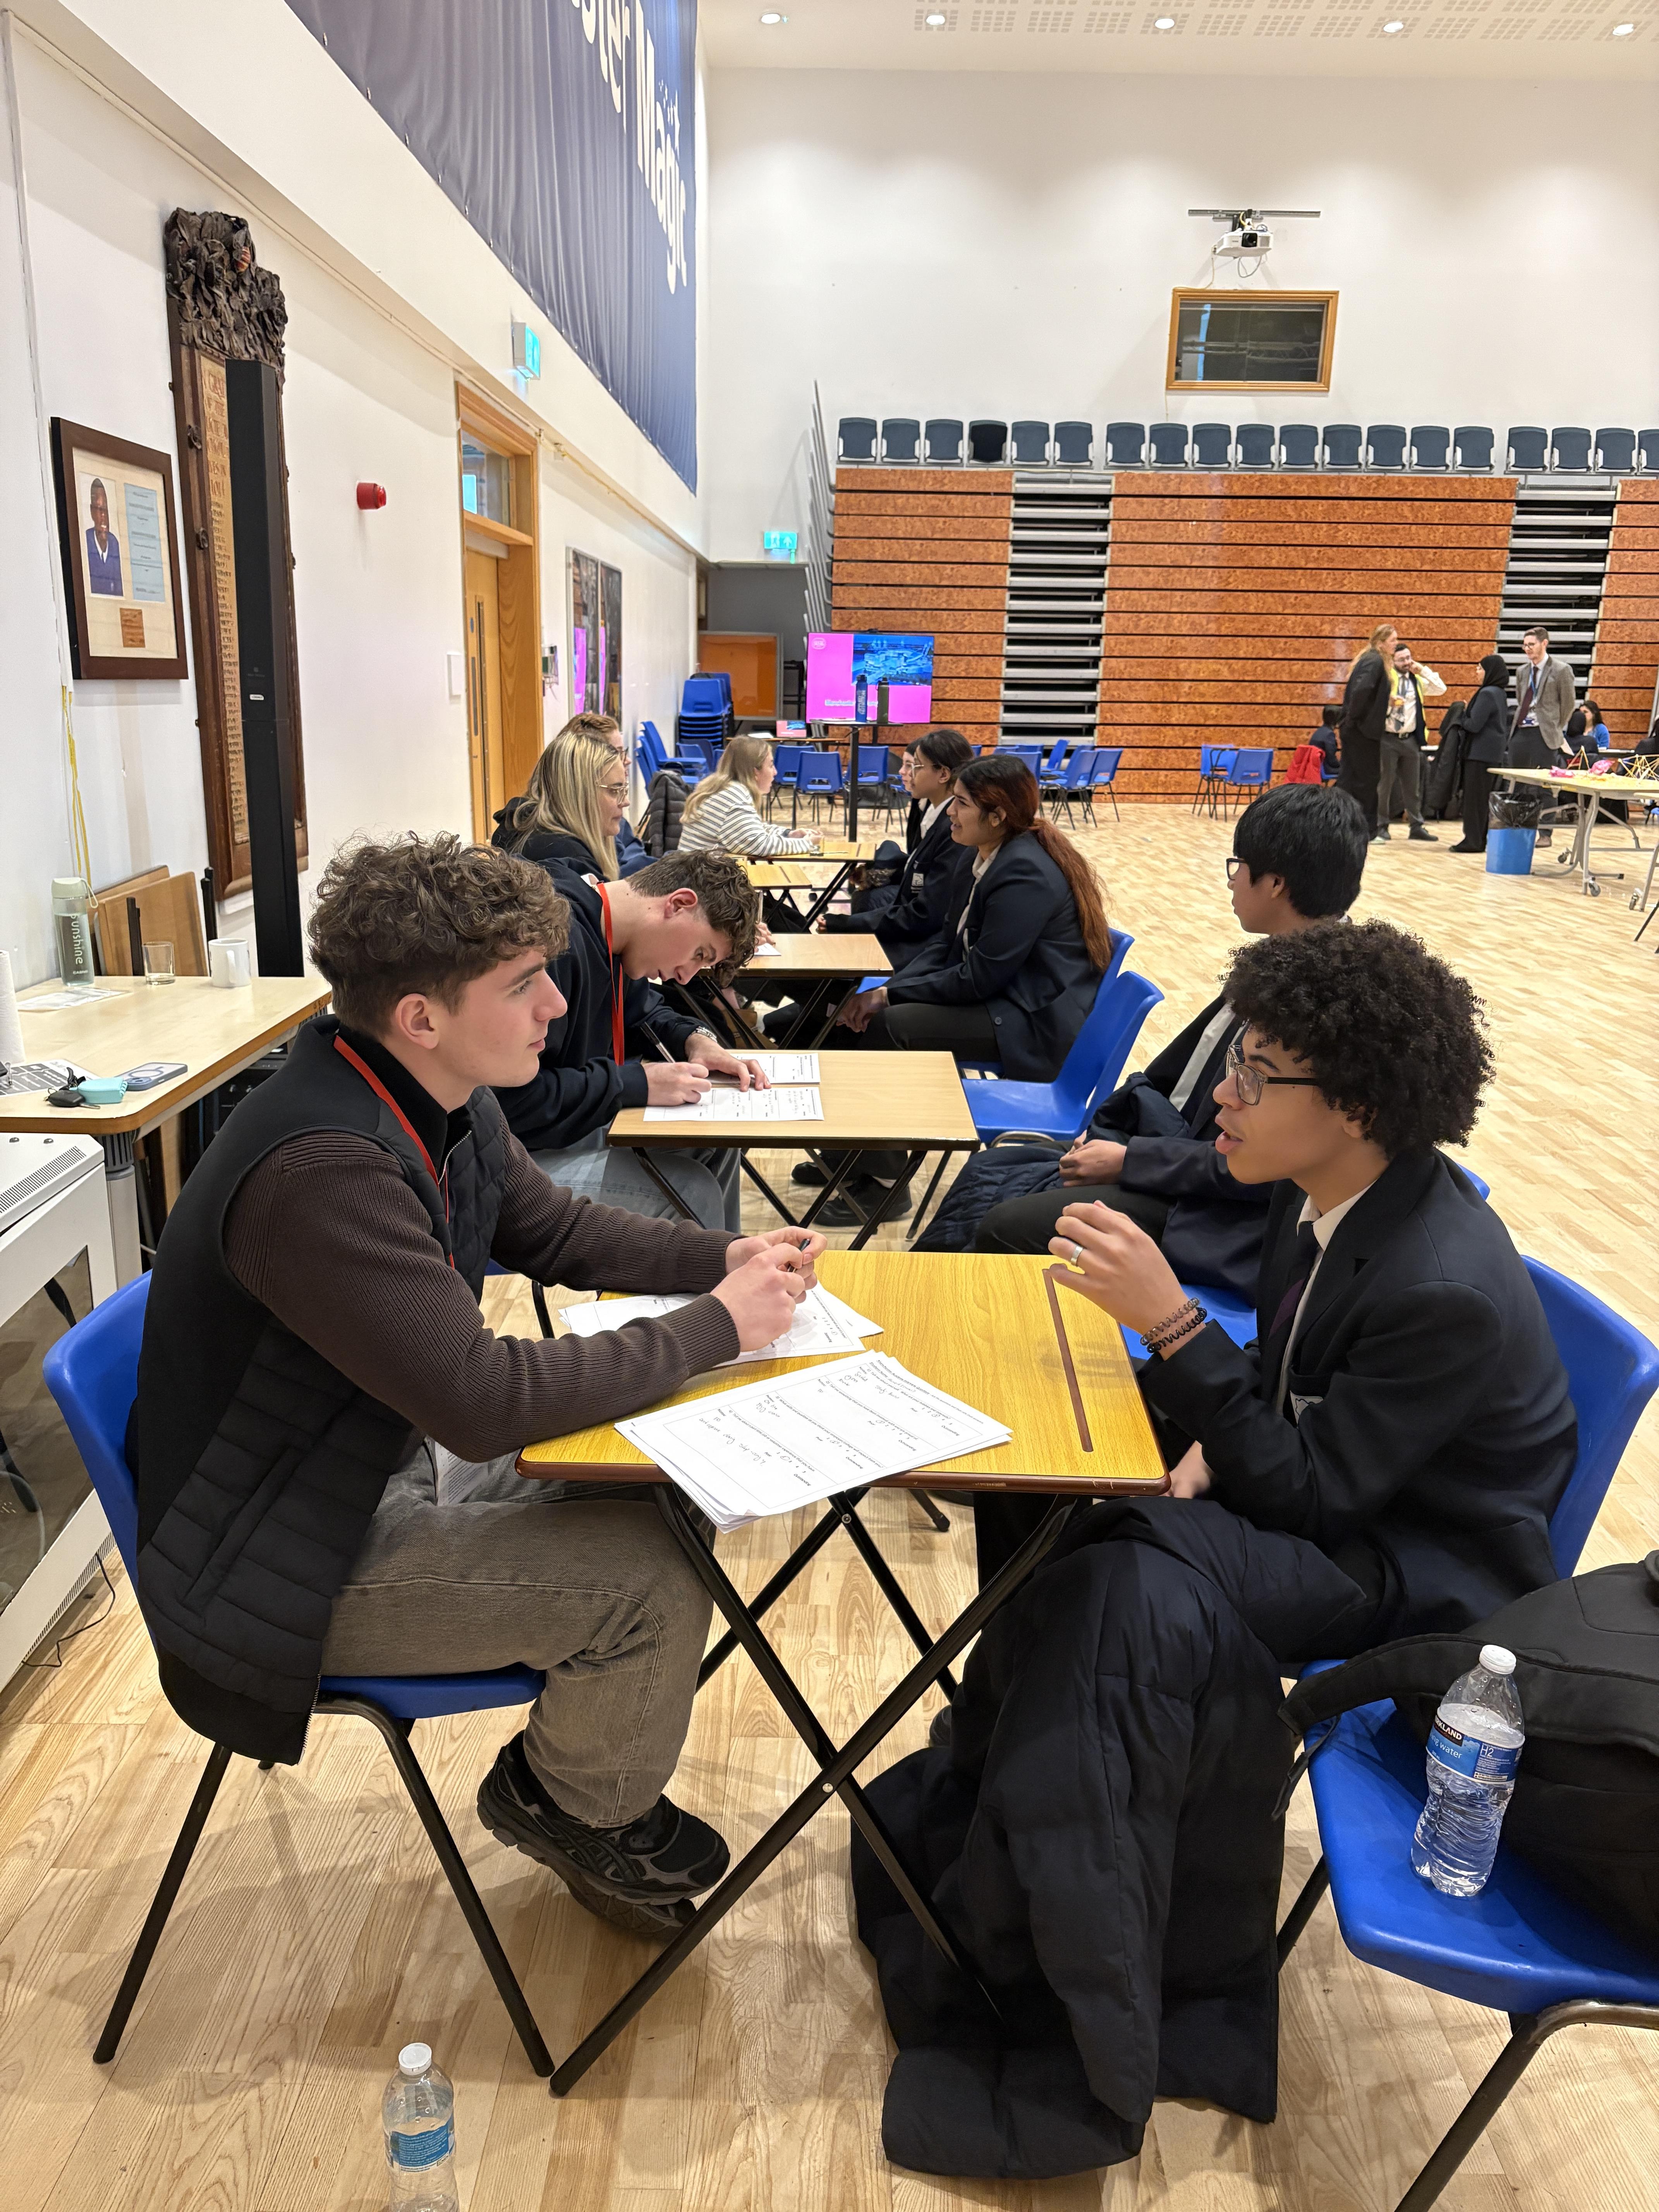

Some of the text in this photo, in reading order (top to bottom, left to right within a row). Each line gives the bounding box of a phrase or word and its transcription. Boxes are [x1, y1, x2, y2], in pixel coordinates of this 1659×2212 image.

[582, 0, 687, 294] er Magic
[1440, 1742, 1463, 1759] water
